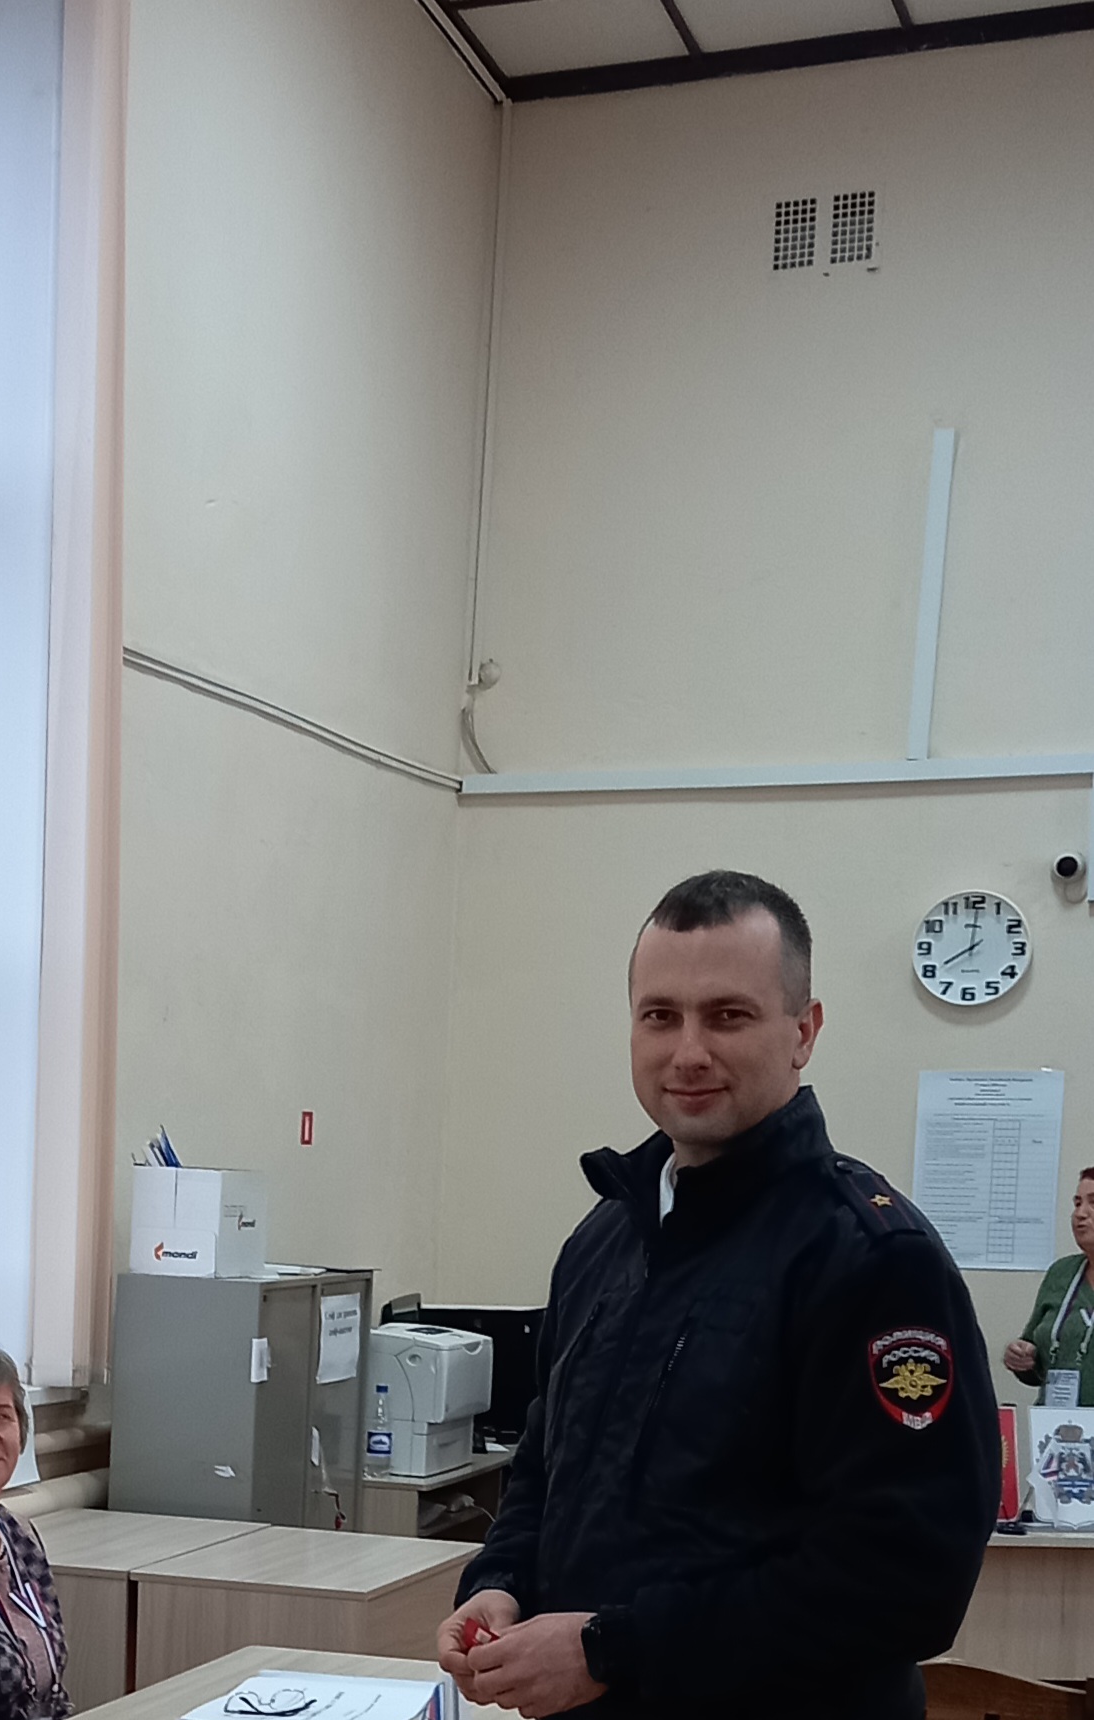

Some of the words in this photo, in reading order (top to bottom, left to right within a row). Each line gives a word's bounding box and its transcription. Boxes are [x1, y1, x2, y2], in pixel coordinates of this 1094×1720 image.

[942, 901, 958, 916] 11
[963, 895, 986, 910] 12
[994, 902, 1001, 916] 1
[924, 919, 943, 933] 10
[1006, 918, 1023, 934] 2
[917, 941, 932, 956] 9
[1011, 941, 1027, 956] 3
[921, 964, 937, 979] 8
[1000, 964, 1018, 979] 4
[939, 981, 954, 996] 7
[961, 986, 976, 1002] 6
[985, 980, 1000, 996] 5
[161, 1250, 198, 1260] mondi
[882, 1346, 940, 1368] РОССИЯ
